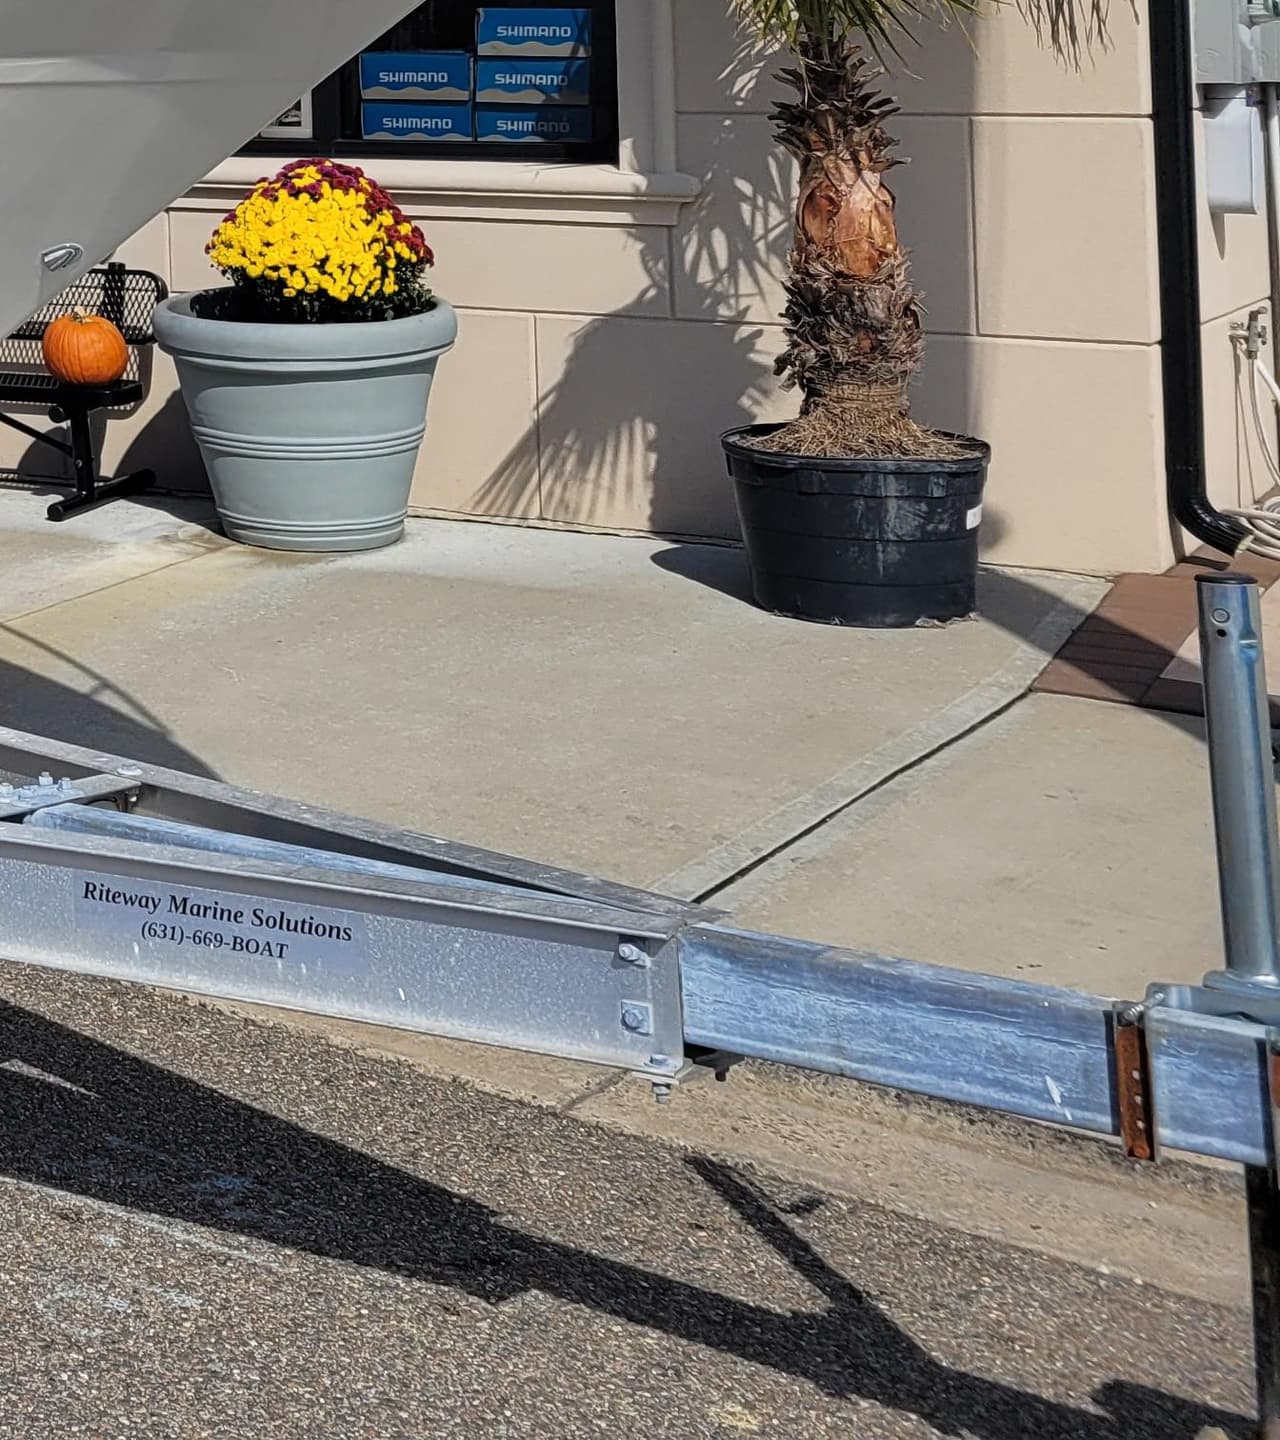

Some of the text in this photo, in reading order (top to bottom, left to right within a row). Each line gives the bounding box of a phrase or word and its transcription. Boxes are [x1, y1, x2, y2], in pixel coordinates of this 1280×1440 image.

[496, 25, 571, 37] SHIMANO
[378, 71, 449, 83] SHIMANO
[494, 73, 568, 86] SHIMANO
[382, 117, 452, 130] SHIMANO
[496, 119, 570, 133] SHIMANO
[82, 881, 353, 942] Riteway Marine Solutions
[141, 920, 289, 959] (631)-669-BOAT
